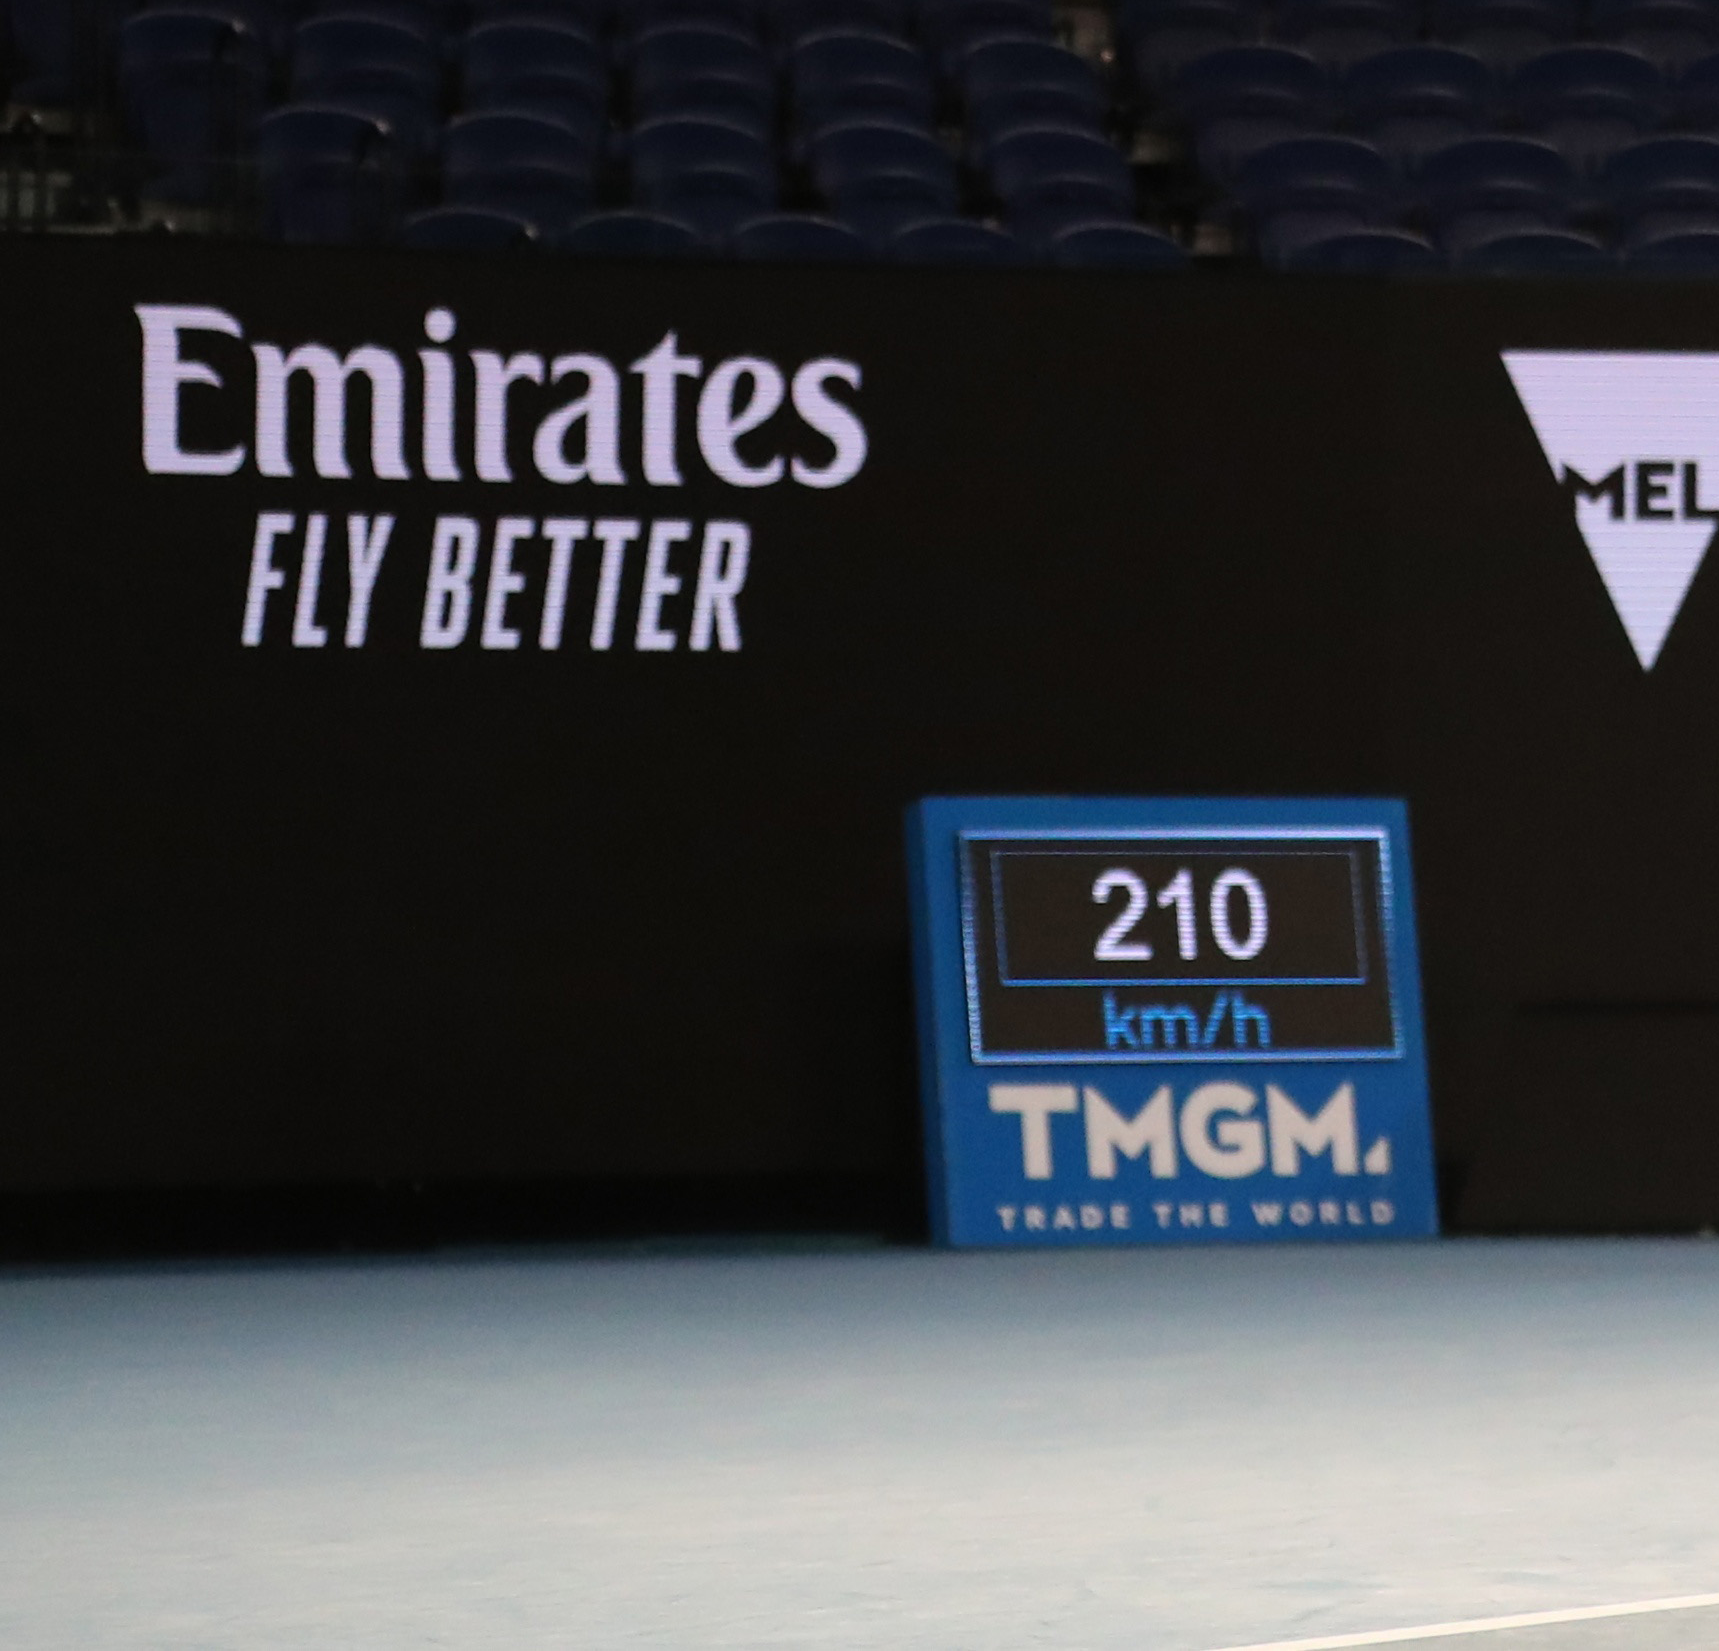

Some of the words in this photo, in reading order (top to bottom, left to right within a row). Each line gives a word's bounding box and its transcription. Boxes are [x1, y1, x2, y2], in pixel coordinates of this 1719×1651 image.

[135, 306, 866, 488] Emirates
[242, 514, 393, 647] FLY
[421, 517, 749, 651] BETTER
[1092, 869, 1268, 960] 210
[1103, 990, 1271, 1047] km/h
[996, 1203, 1131, 1231] TRADE
[1153, 1201, 1230, 1228] THE
[1252, 1199, 1395, 1226] WORLD
